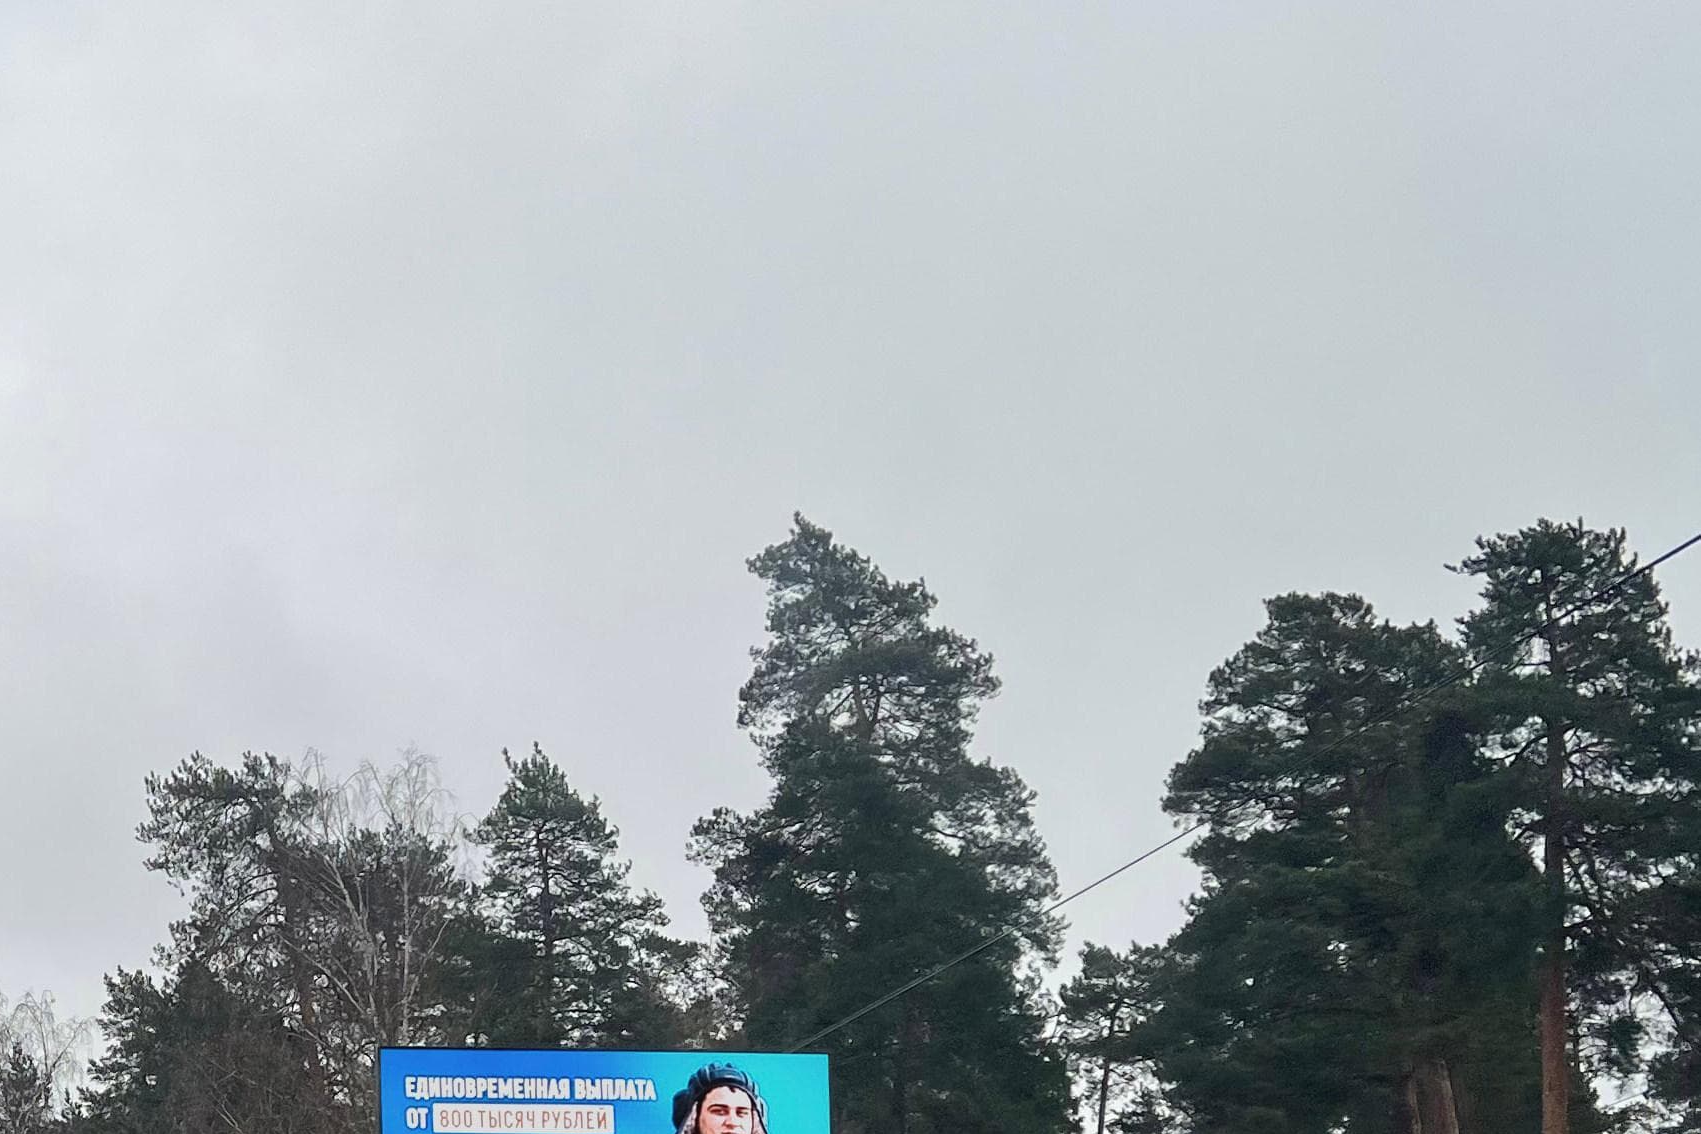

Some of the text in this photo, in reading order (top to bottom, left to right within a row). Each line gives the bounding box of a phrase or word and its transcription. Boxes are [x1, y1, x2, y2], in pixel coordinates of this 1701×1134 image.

[405, 1076, 657, 1100] ЕДИНОВРЕМЕННАЯ ВЫПЛАТА
[406, 1107, 608, 1130] ОТ 800 ТЫСЯЧ РУБЛЕЙ
